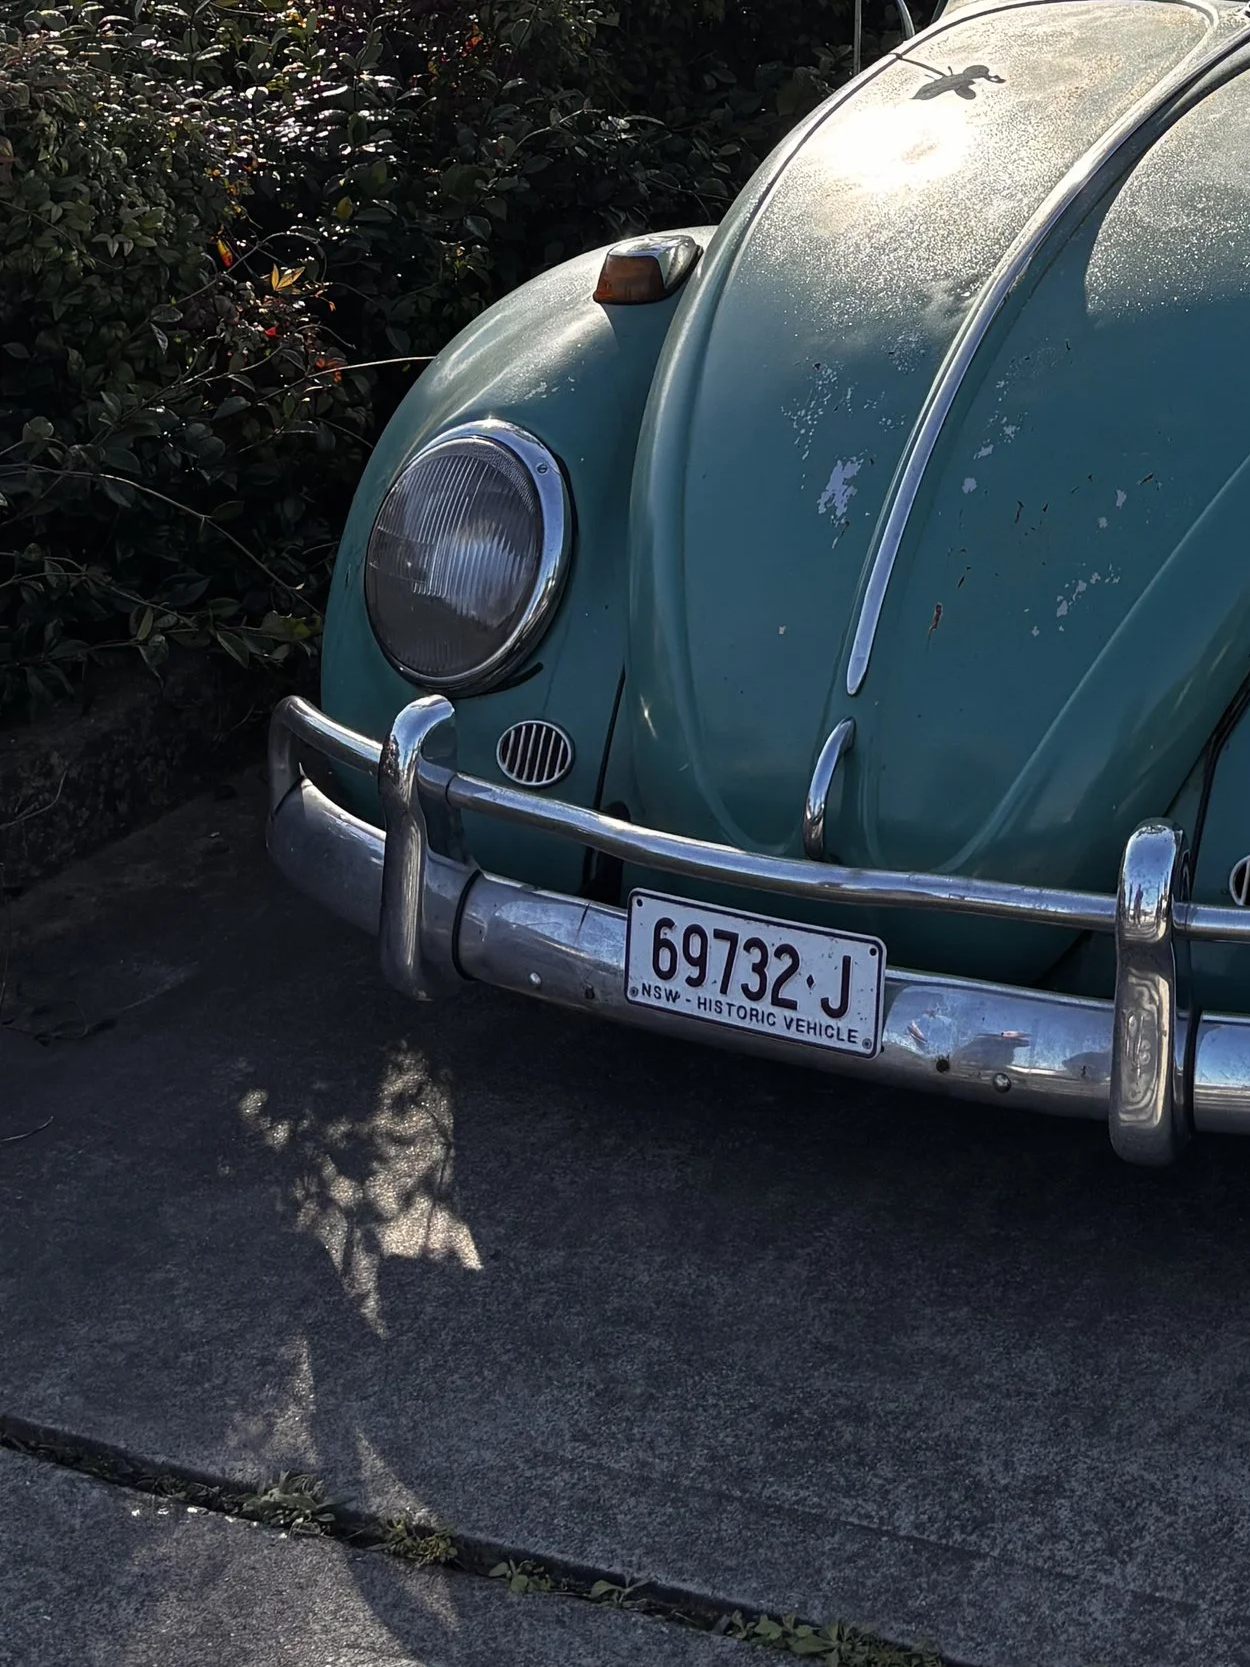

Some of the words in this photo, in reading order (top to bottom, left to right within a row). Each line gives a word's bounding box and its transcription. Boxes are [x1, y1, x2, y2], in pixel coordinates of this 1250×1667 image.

[652, 917, 800, 1011] 69732
[641, 982, 679, 1003] NSW
[697, 995, 776, 1027] HISTORIC
[783, 1015, 859, 1044] VEHICLE
